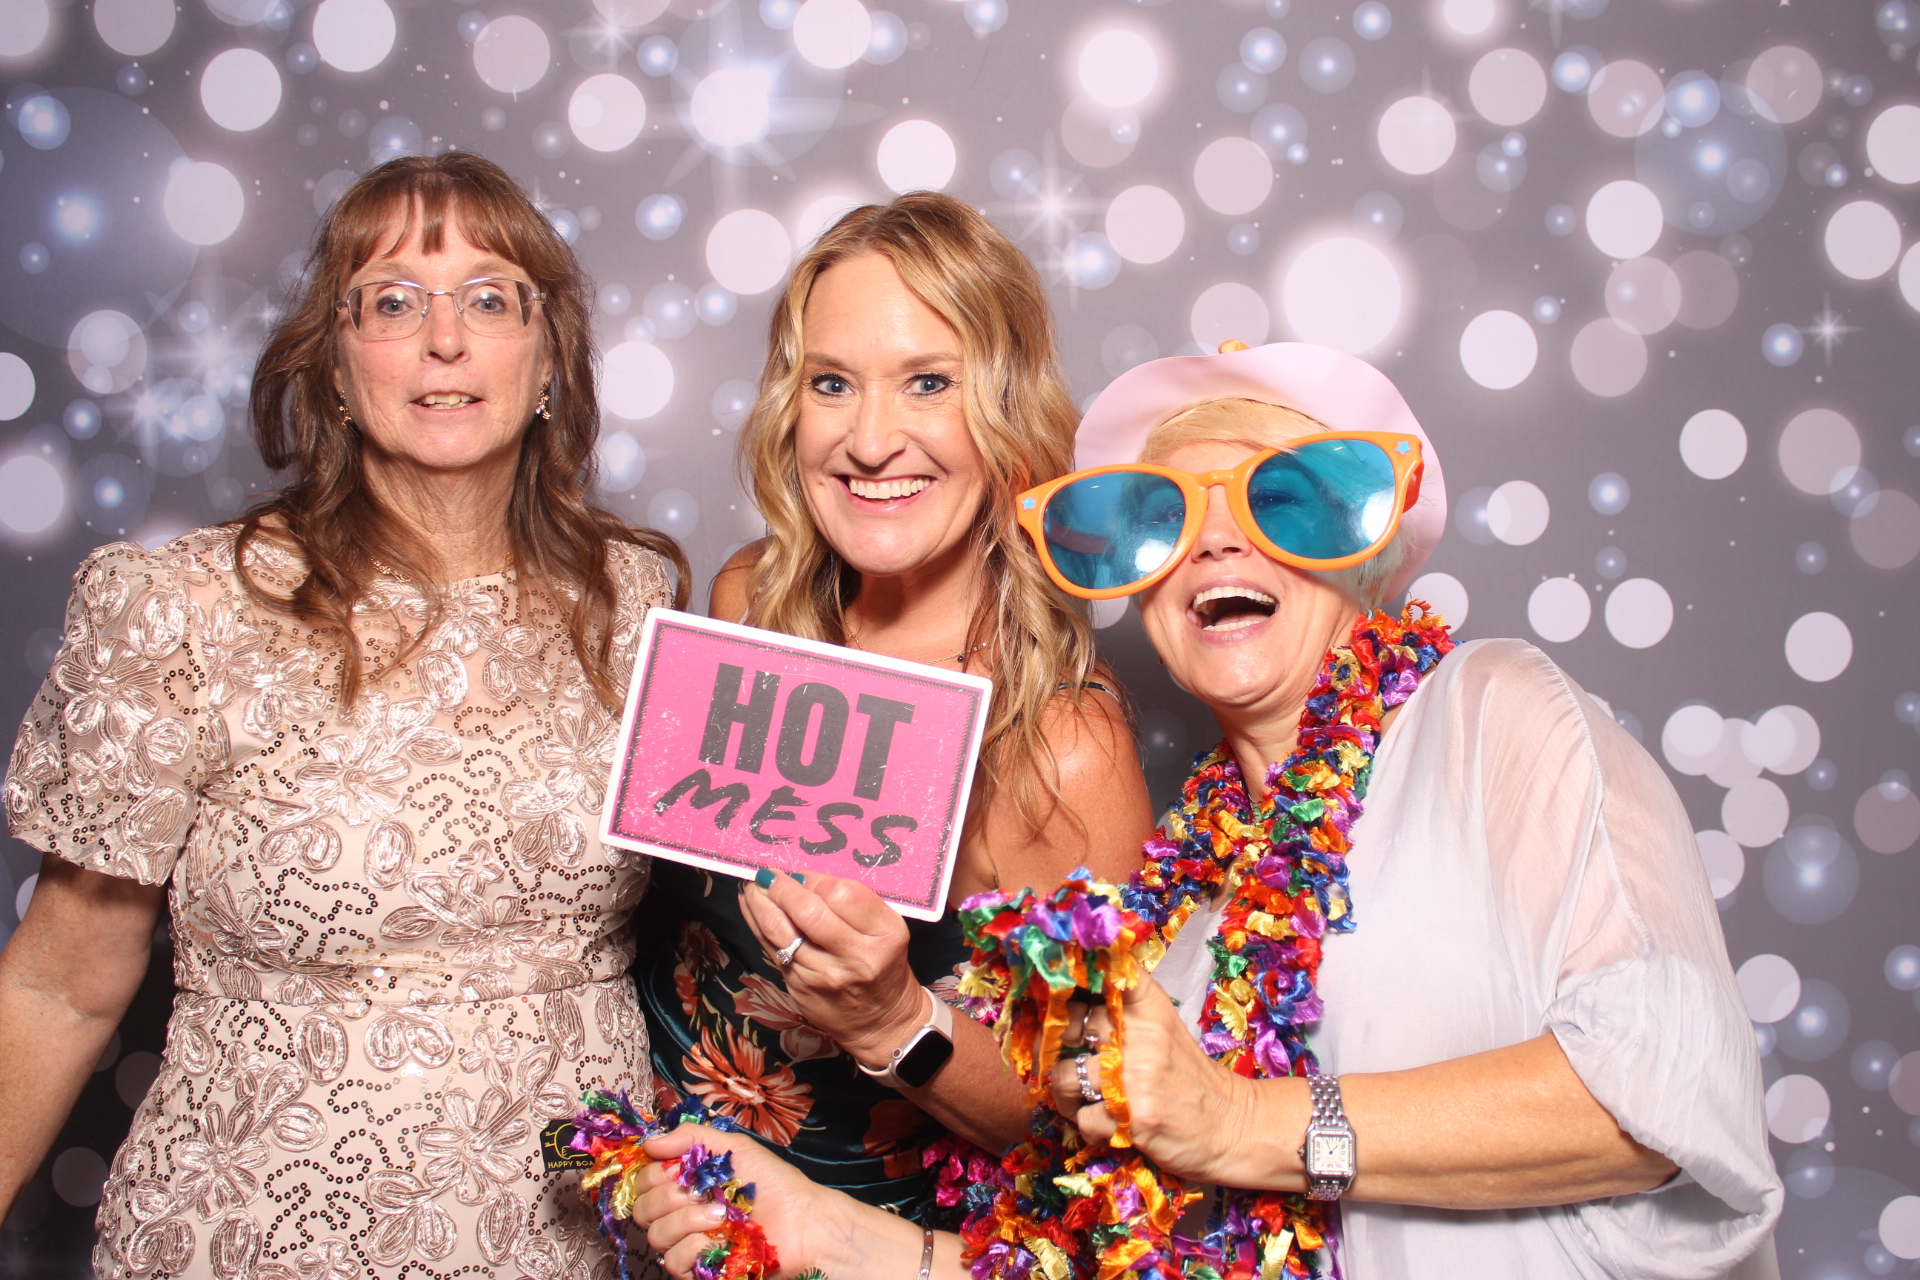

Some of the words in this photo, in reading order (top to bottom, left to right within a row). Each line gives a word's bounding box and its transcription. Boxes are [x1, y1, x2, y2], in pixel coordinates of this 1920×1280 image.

[698, 662, 915, 802] HOT
[653, 768, 918, 868] MESS
[547, 1161, 573, 1169] HAPPY
